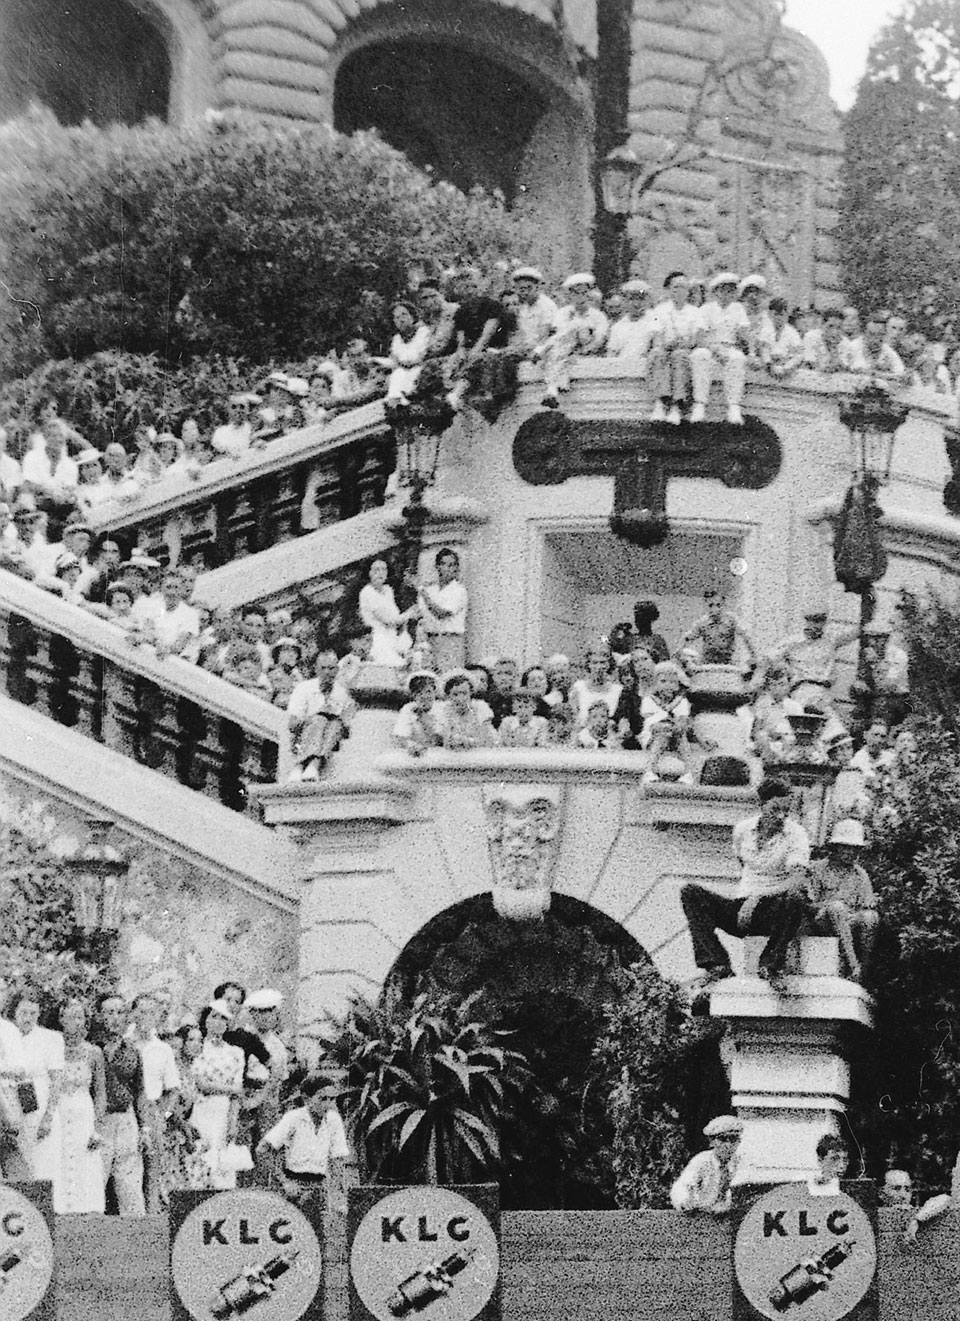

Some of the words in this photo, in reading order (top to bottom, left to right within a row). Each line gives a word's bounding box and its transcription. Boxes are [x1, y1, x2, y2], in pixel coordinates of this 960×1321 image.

[202, 1217, 294, 1246] KLC
[380, 1215, 471, 1243] KLC
[762, 1209, 850, 1238] KLC
